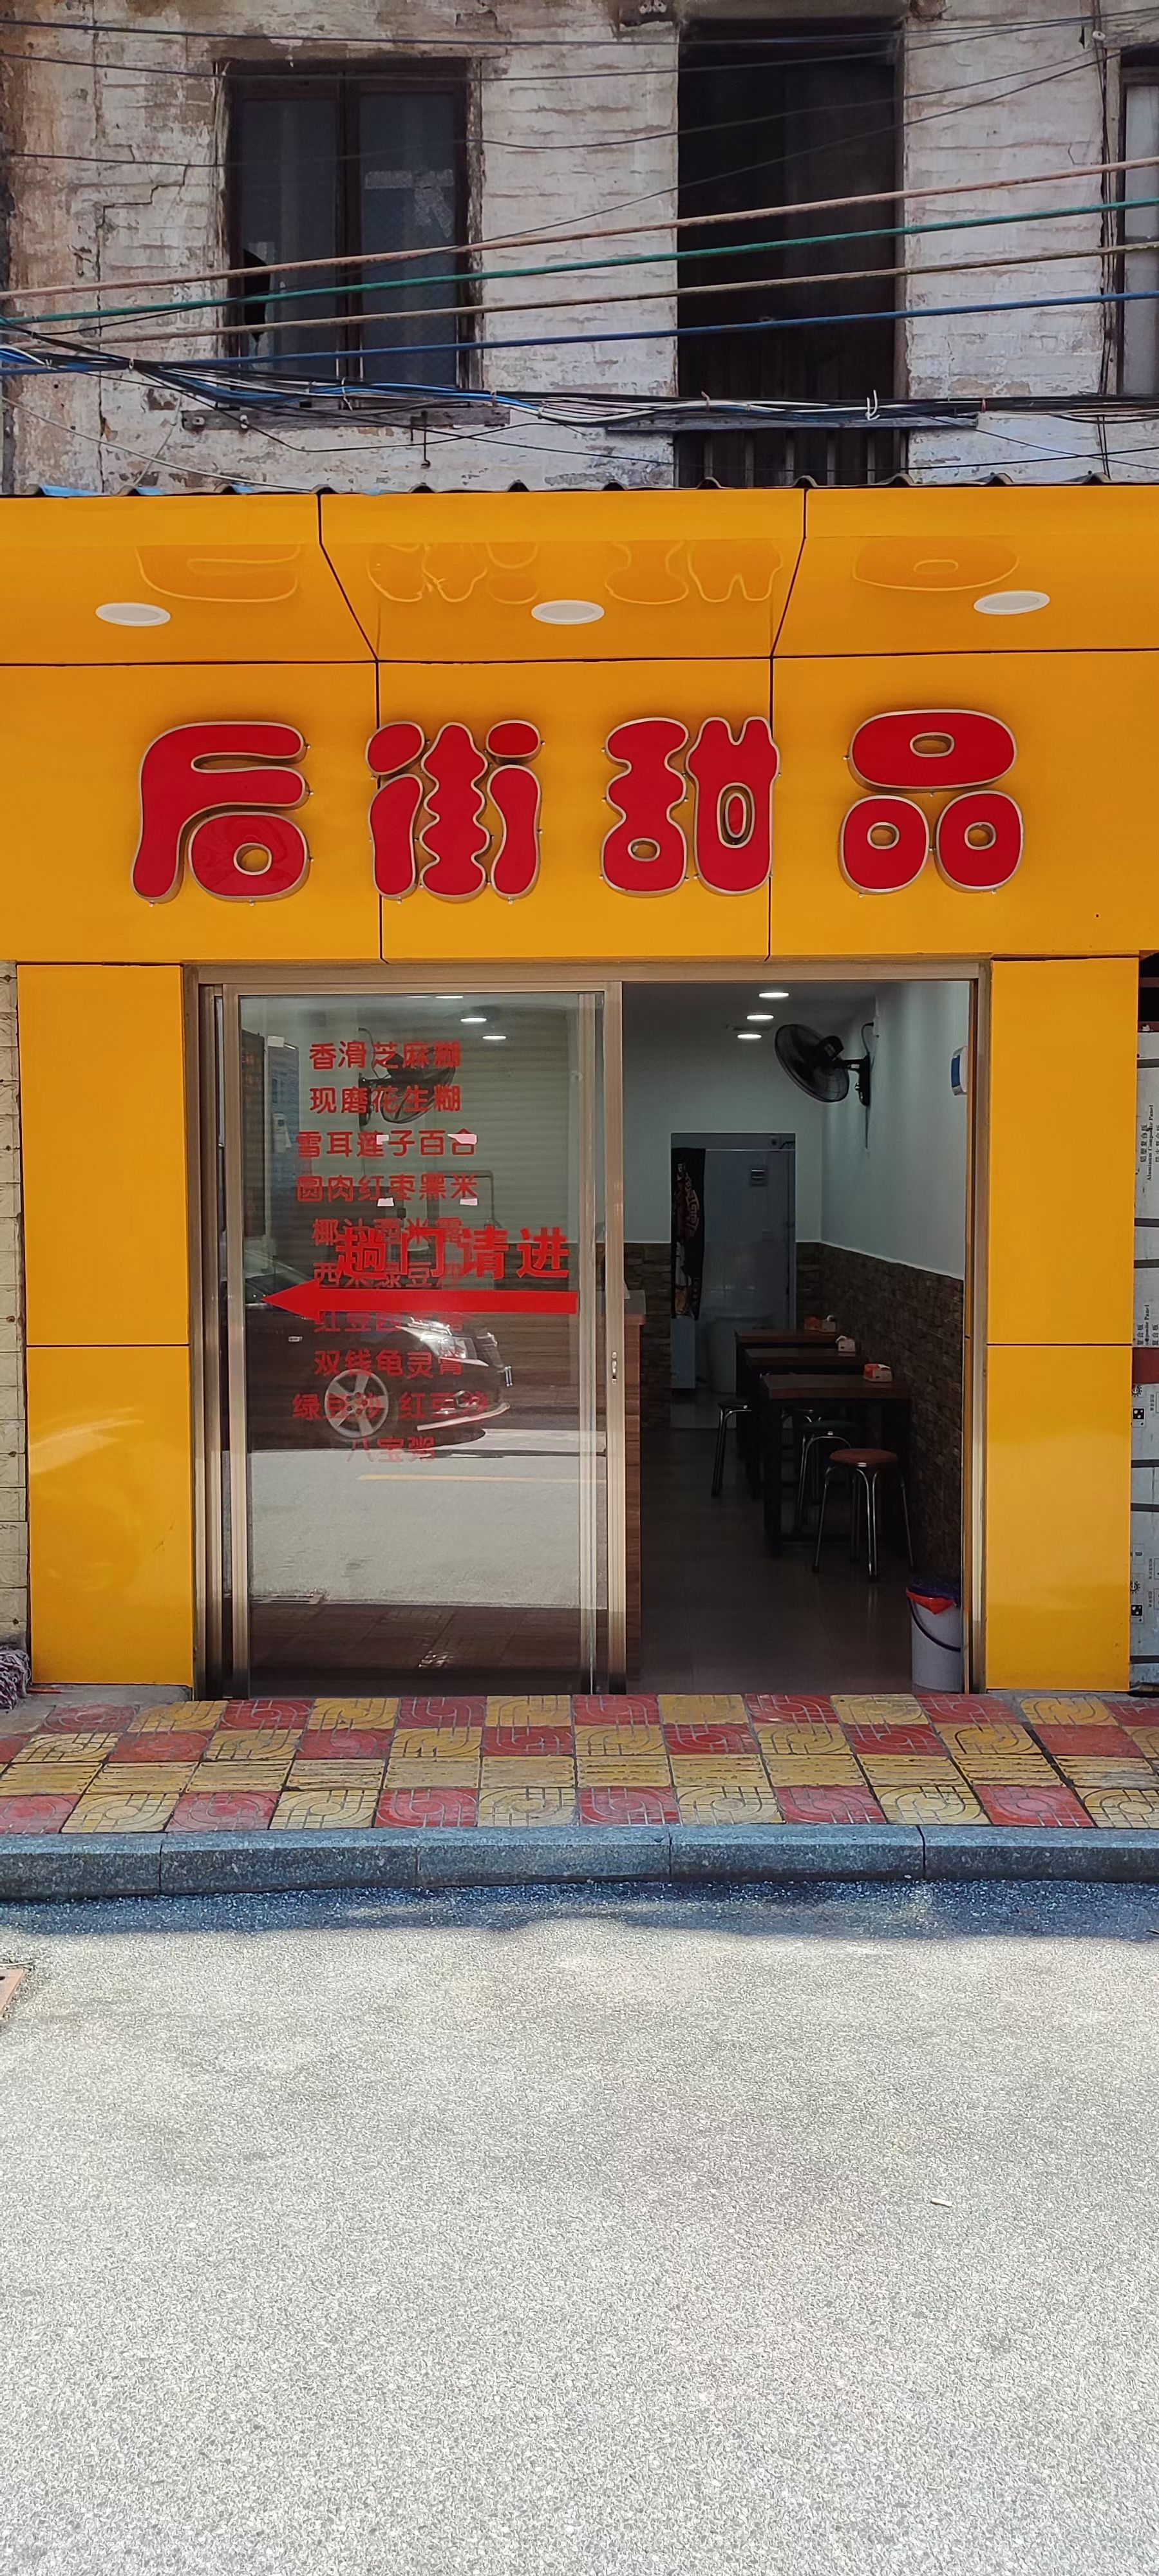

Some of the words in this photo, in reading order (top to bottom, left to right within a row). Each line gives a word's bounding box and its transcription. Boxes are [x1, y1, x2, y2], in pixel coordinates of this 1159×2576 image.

[133, 709, 1023, 902] 后街甜品
[309, 1041, 461, 1070] 香滑芝麻糊
[309, 1085, 461, 1113] 现磨花生糊
[296, 1128, 477, 1157] 雪耳莲子百合
[335, 1226, 569, 1280] 趟门请进
[347, 1435, 435, 1463] 八宝粥
